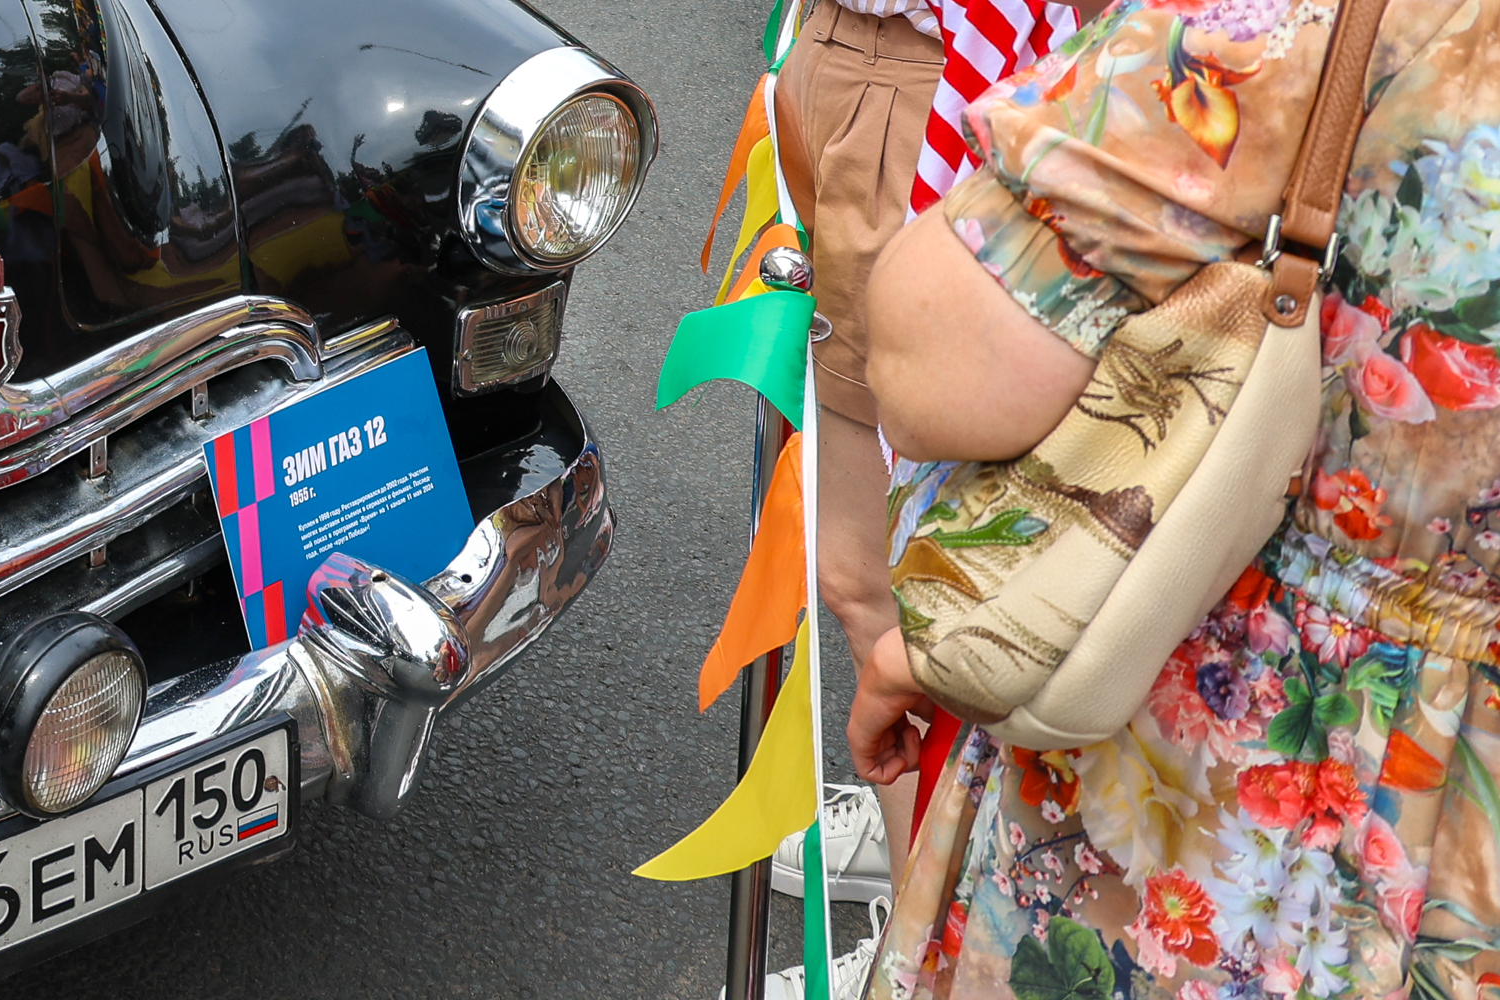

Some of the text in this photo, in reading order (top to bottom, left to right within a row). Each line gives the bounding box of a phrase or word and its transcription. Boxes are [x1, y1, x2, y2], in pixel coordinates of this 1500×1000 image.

[282, 415, 387, 487] ЗИМ ГАЗ 12
[289, 486, 317, 508] 1955 г.
[380, 486, 387, 494] до
[408, 466, 430, 480] Участник
[300, 528, 319, 541] многих
[318, 518, 341, 533] выставок
[365, 496, 388, 511] сериалах
[303, 540, 314, 551] ний
[313, 534, 328, 546] показ
[389, 497, 407, 509] канале
[412, 489, 423, 498] мая
[422, 482, 434, 494] 2024
[318, 542, 334, 554] после
[152, 746, 266, 843] 150
[178, 824, 234, 866] RUS
